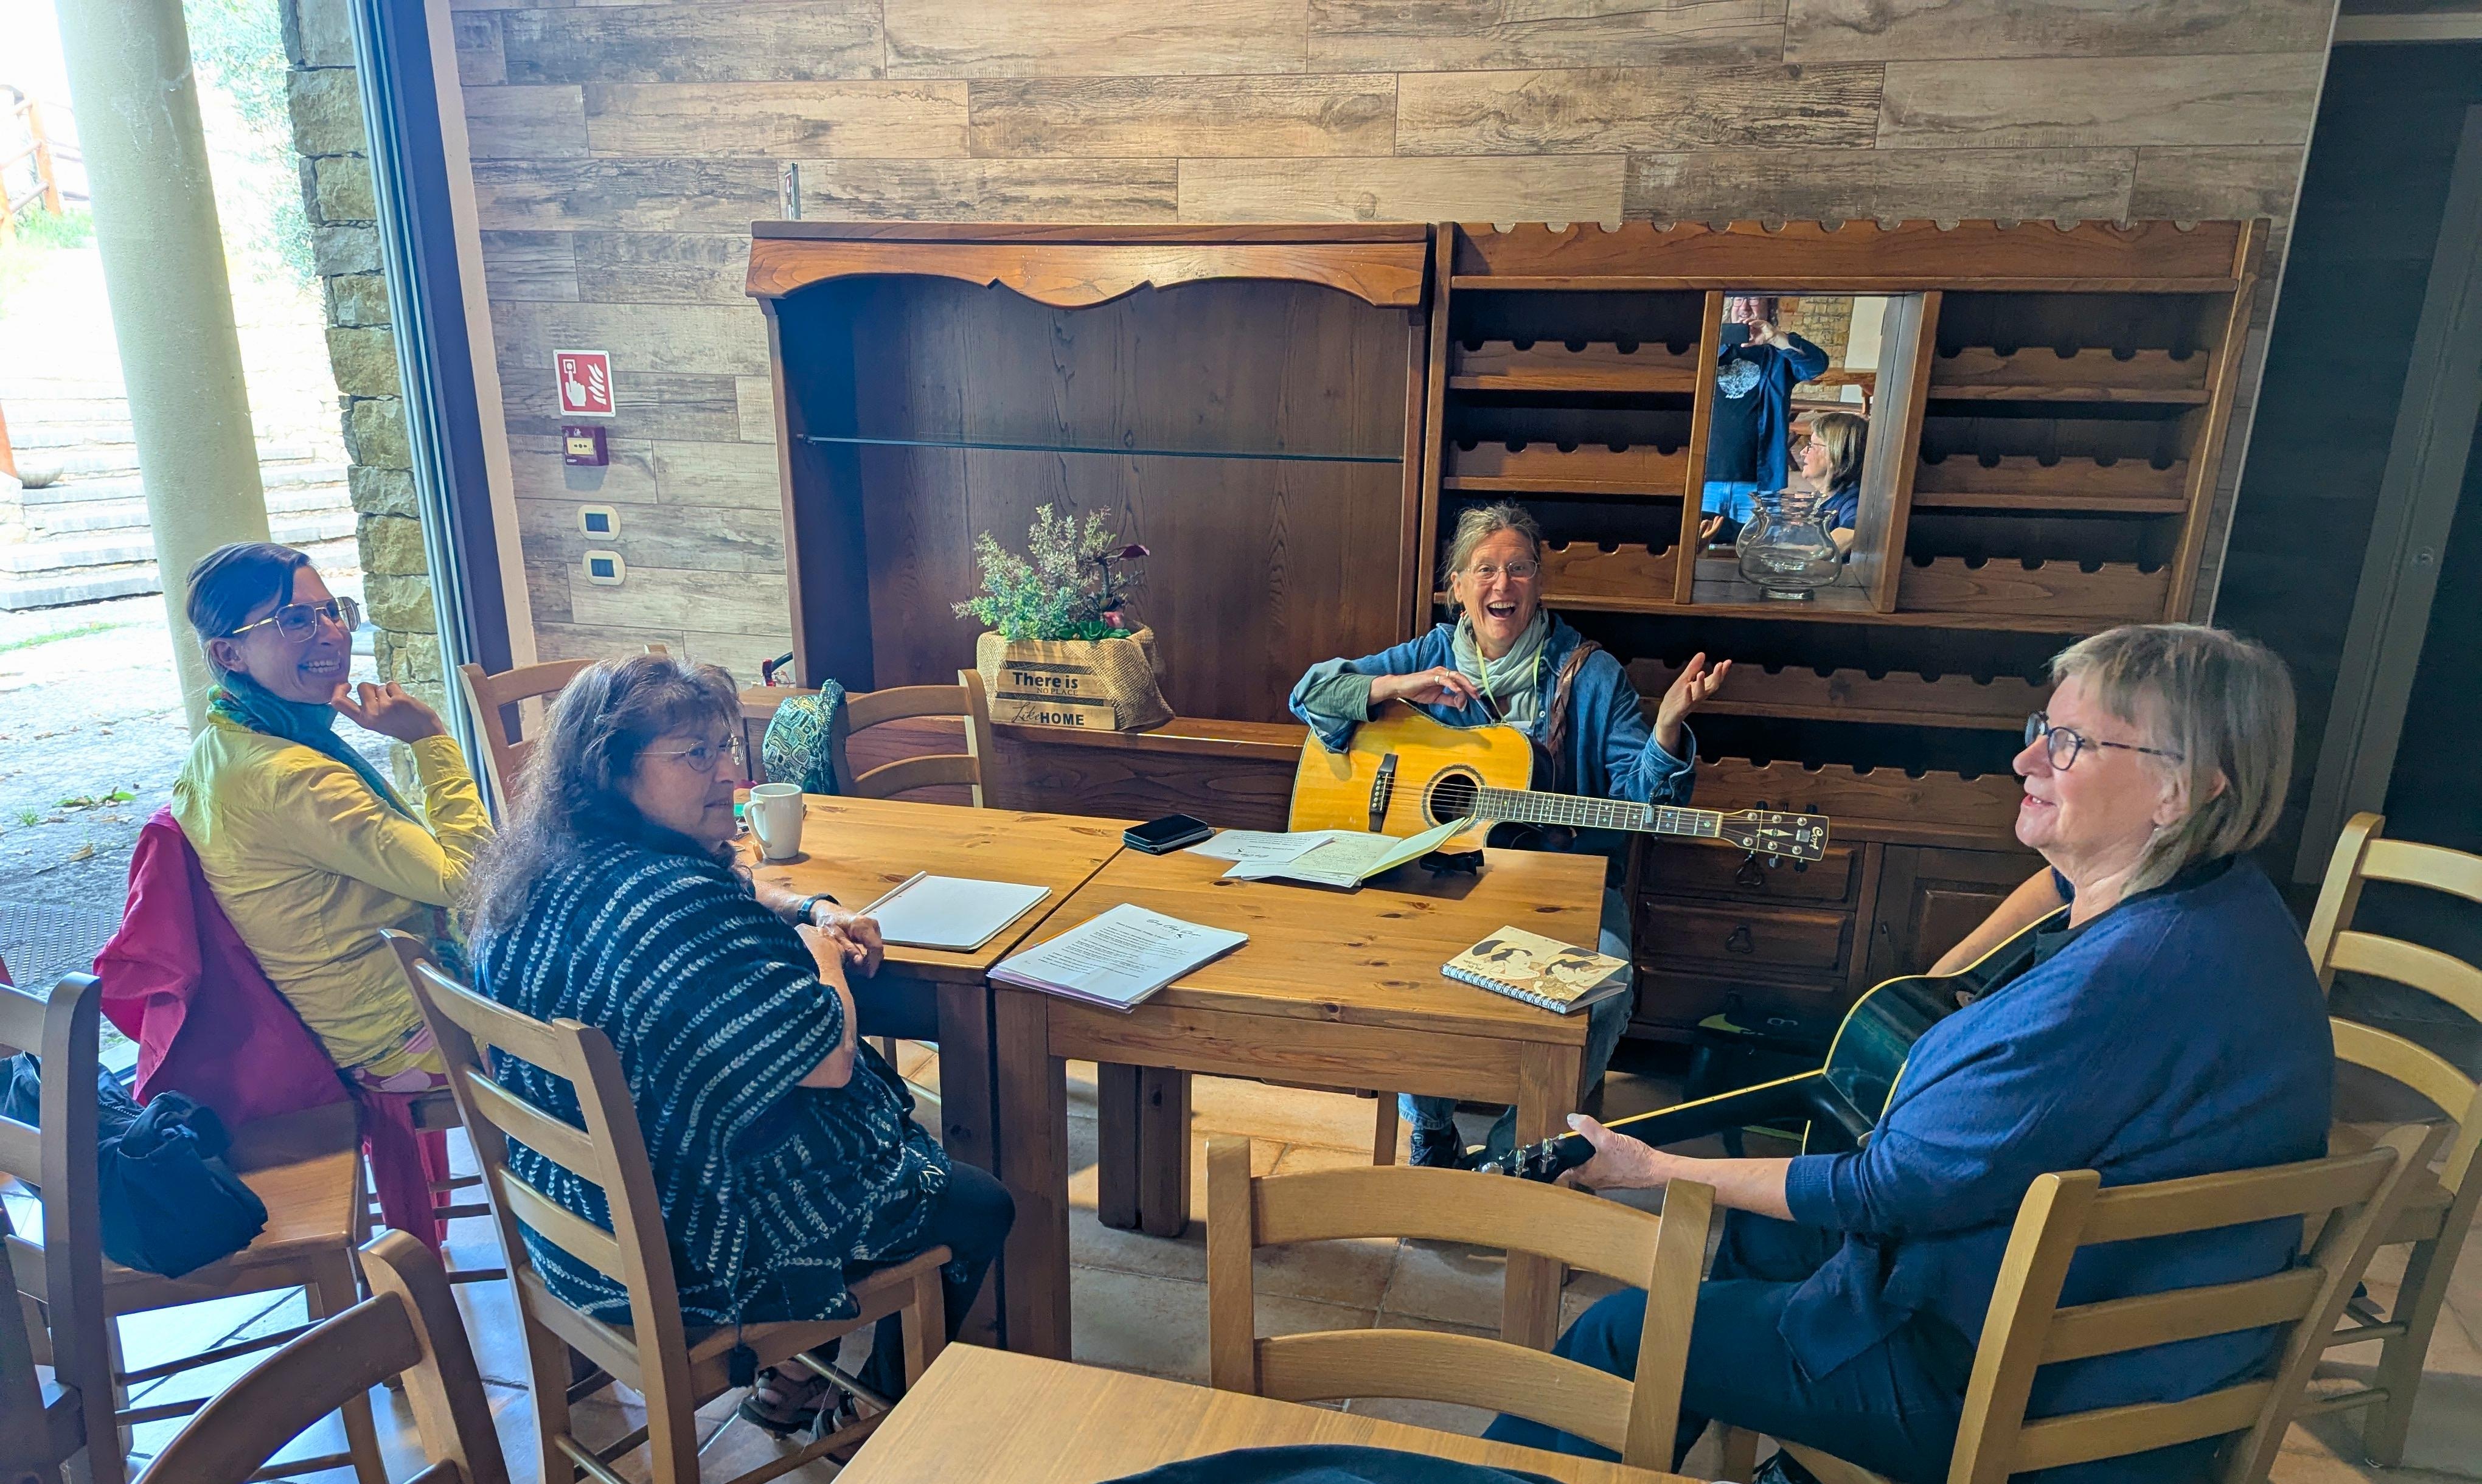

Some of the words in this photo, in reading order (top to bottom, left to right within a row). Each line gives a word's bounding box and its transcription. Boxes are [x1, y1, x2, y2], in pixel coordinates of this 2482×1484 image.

[1012, 671, 1062, 688] There
[1065, 675, 1079, 688] is
[1011, 701, 1040, 723] Like
[1040, 712, 1084, 726] HOME
[1809, 826, 1823, 850] Cort
